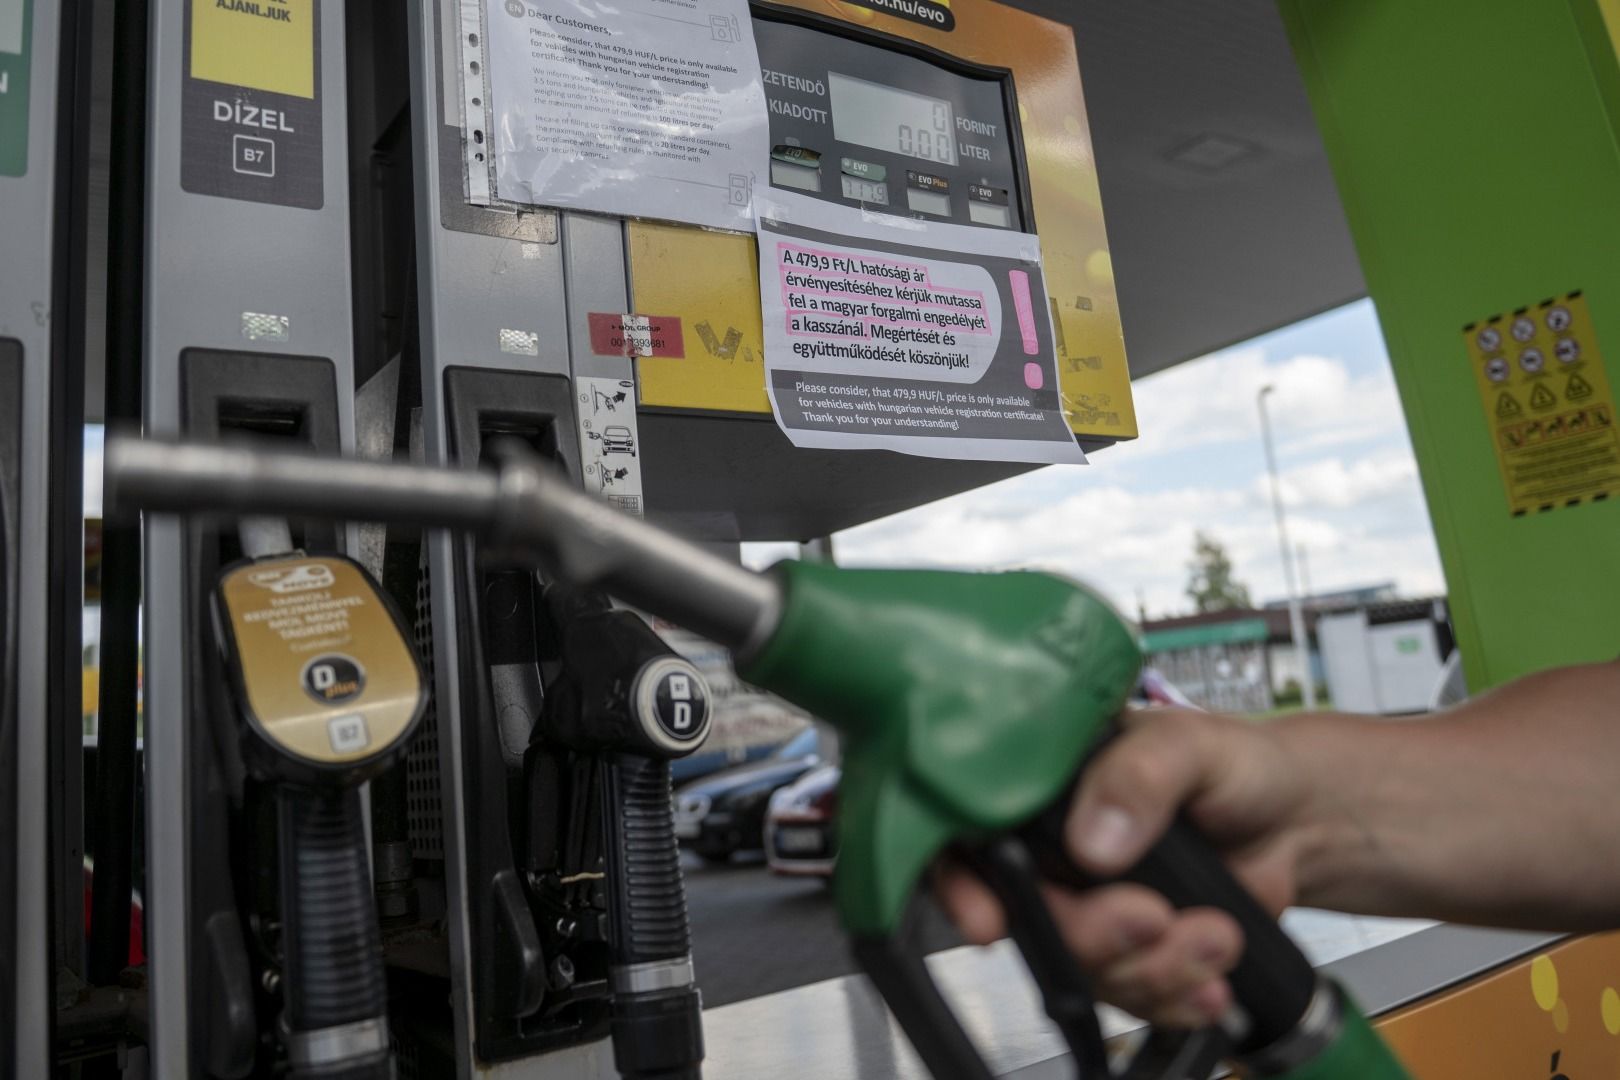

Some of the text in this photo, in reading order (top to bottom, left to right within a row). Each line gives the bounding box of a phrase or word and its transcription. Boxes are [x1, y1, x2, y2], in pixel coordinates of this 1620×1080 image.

[528, 8, 612, 36] Dear Customers,
[869, 0, 944, 23] ol.hu/evo
[529, 27, 556, 39] Please
[595, 42, 611, 51] that
[635, 50, 659, 61] HUF/L
[660, 56, 678, 66] price
[688, 61, 704, 71] only
[705, 62, 738, 74] available
[530, 38, 710, 79] for vehicles with hungarian vehicle registration
[577, 58, 603, 70] Thank
[604, 65, 618, 74] you
[620, 66, 631, 75] for
[653, 74, 709, 90] understanding!
[578, 84, 612, 96] Hungian
[214, 98, 294, 133] DÍZEL
[770, 99, 828, 124] KIADOTT
[956, 117, 996, 137] FORINT
[244, 148, 264, 163] B7
[687, 154, 701, 163] with
[960, 143, 991, 161] LITER
[853, 163, 868, 172] EVO
[918, 175, 949, 188] EVO Plus
[979, 188, 992, 198] EVO
[783, 250, 924, 283] A 479,9 Ft/L hatósági ár
[786, 271, 982, 309] érvényesítéséhez kérjük mutassa
[788, 293, 986, 330] fel a magyar forgalmi engedélyét
[791, 316, 955, 346] a kasszánál. Megértését és
[793, 341, 970, 370] együttműködését köszönjük!
[795, 381, 1030, 407] Please consider, that 479,9 HUF/L price is only available
[798, 396, 1045, 421] for vehicles with hungarian vehicle registration certificate!
[802, 411, 960, 430] Thank you for your understanding!
[312, 665, 336, 690] D
[674, 701, 691, 729] D
